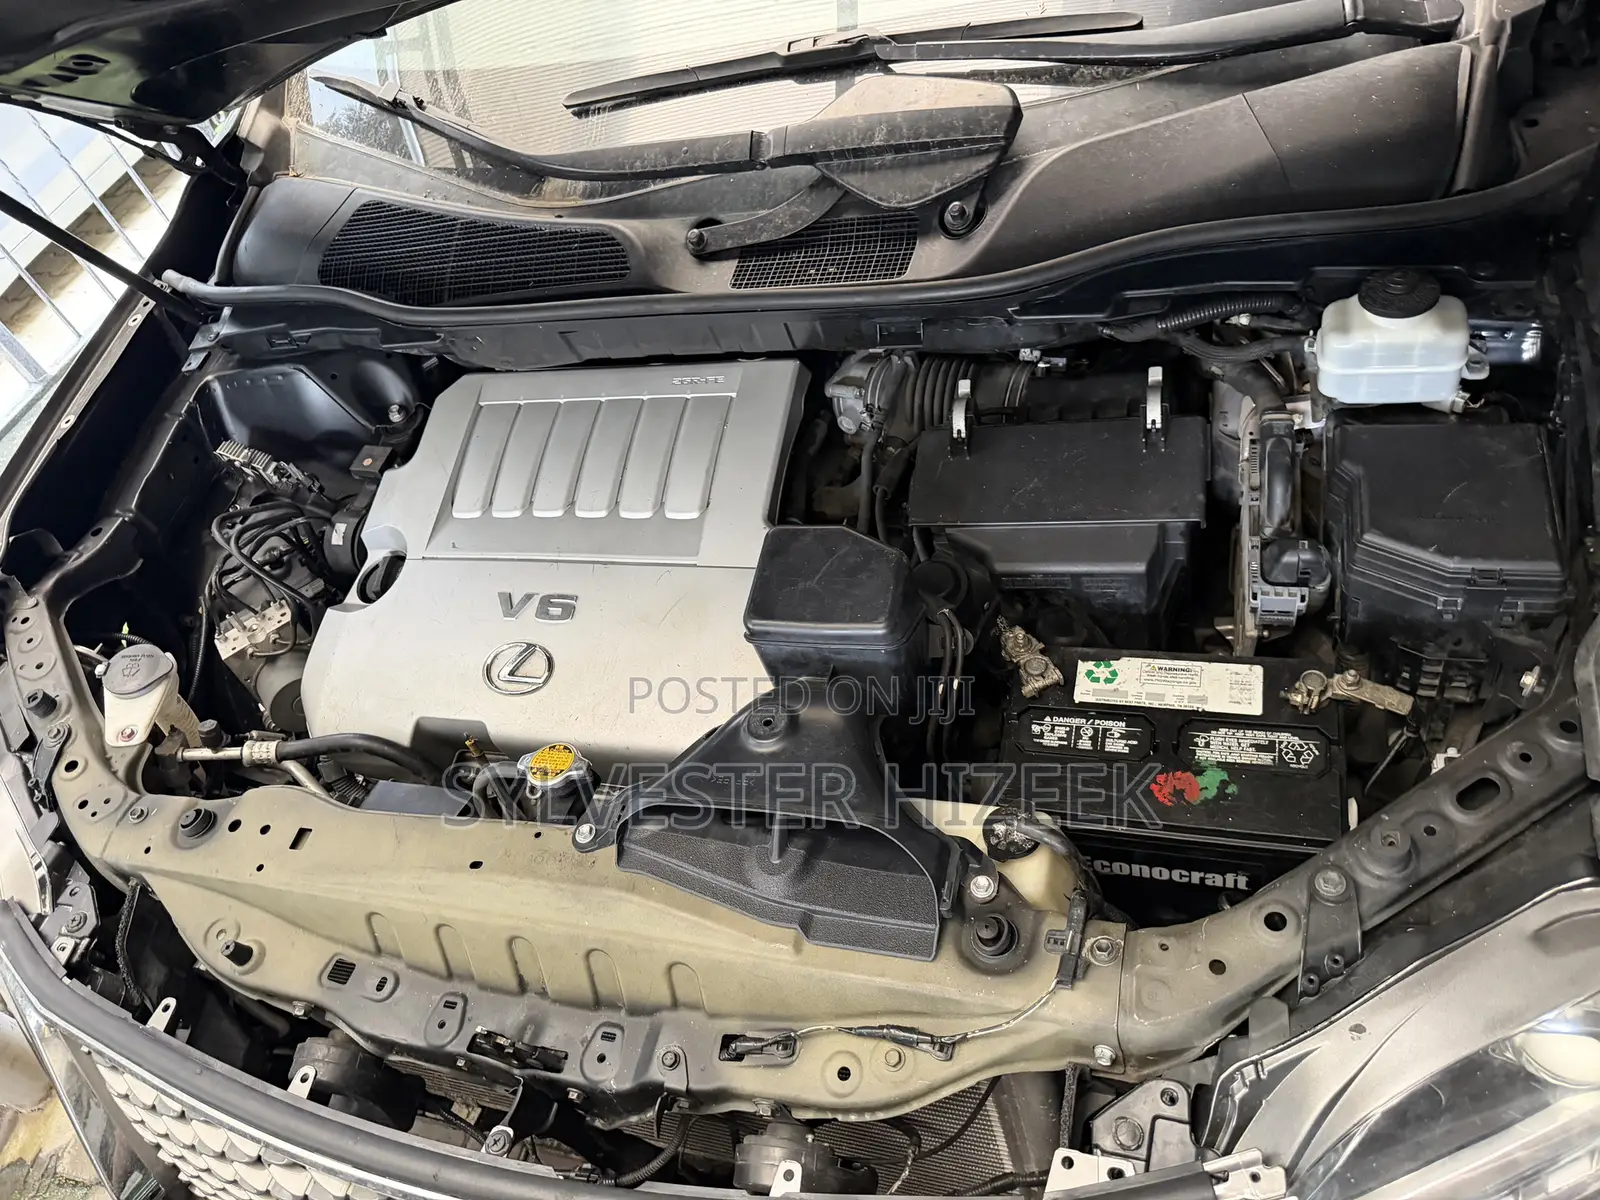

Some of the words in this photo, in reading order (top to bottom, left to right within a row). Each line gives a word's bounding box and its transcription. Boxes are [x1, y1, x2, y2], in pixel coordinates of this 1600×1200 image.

[497, 592, 579, 624] V6
[1053, 716, 1086, 724] DANGER
[1094, 719, 1126, 728] POISON
